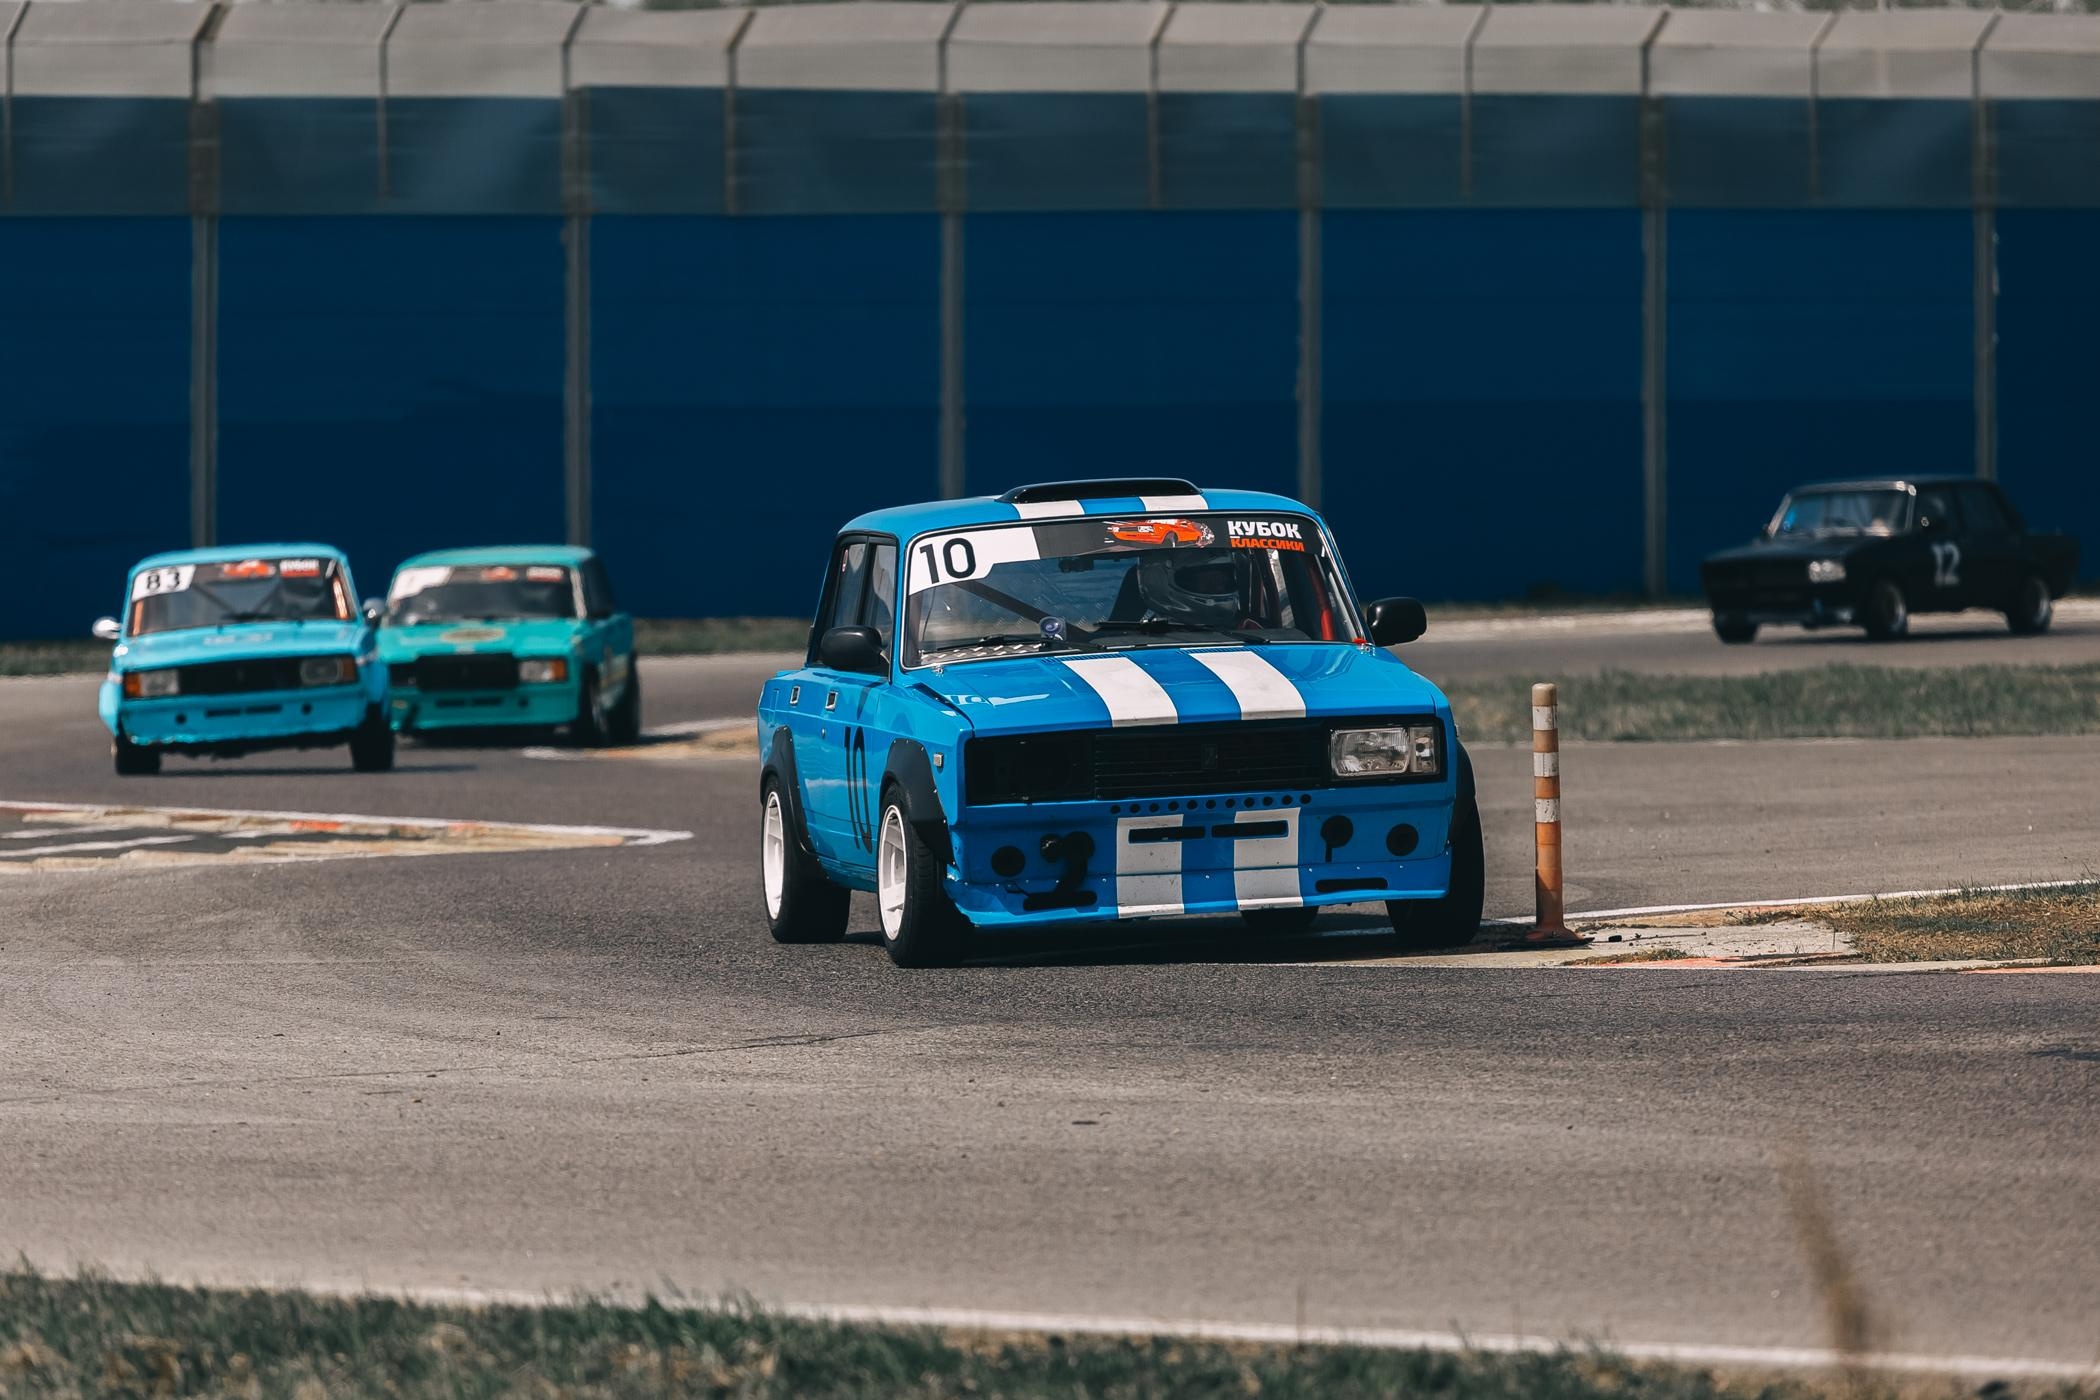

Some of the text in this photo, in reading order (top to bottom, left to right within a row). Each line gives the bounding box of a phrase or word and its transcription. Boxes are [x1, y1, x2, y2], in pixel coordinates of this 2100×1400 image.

[1227, 520, 1302, 539] КУБОК
[1231, 537, 1305, 552] КЛАССИКИ
[919, 537, 977, 585] 10
[1931, 542, 1961, 587] 12
[146, 567, 180, 591] 83
[844, 726, 873, 854] 10
